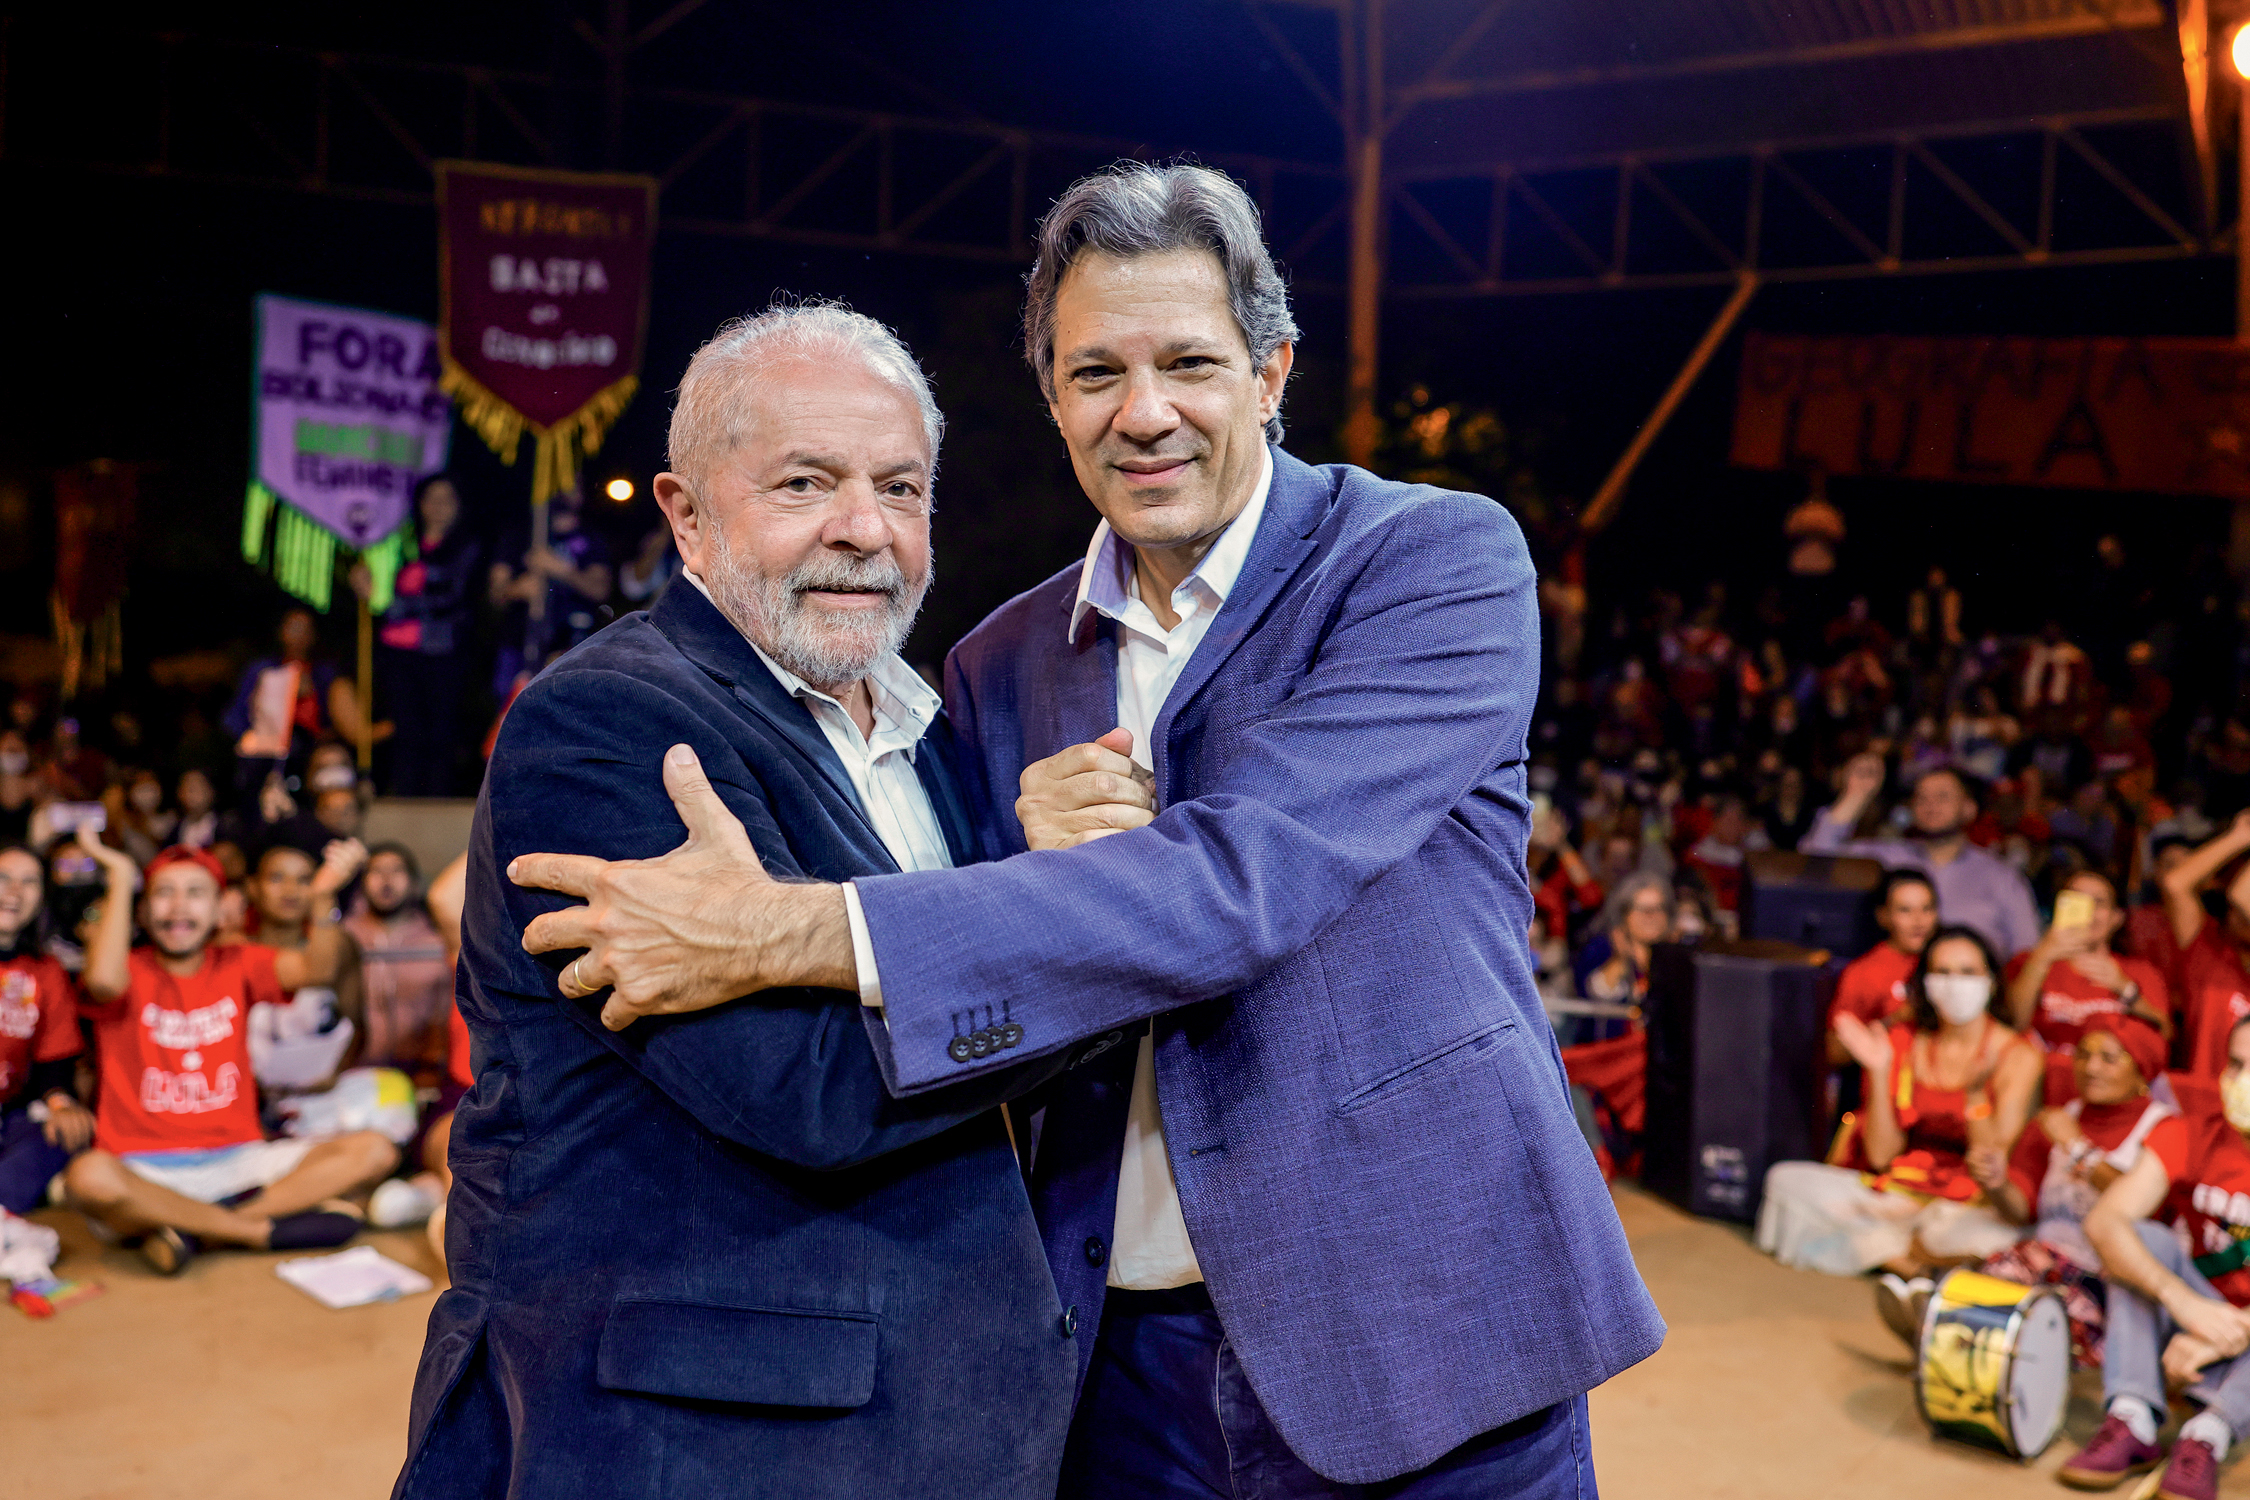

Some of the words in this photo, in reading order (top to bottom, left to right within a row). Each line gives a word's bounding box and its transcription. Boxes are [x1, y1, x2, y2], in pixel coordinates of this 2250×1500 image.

[488, 252, 611, 297] BASTA
[297, 320, 441, 383] FORA
[1780, 388, 2121, 484] LULA
